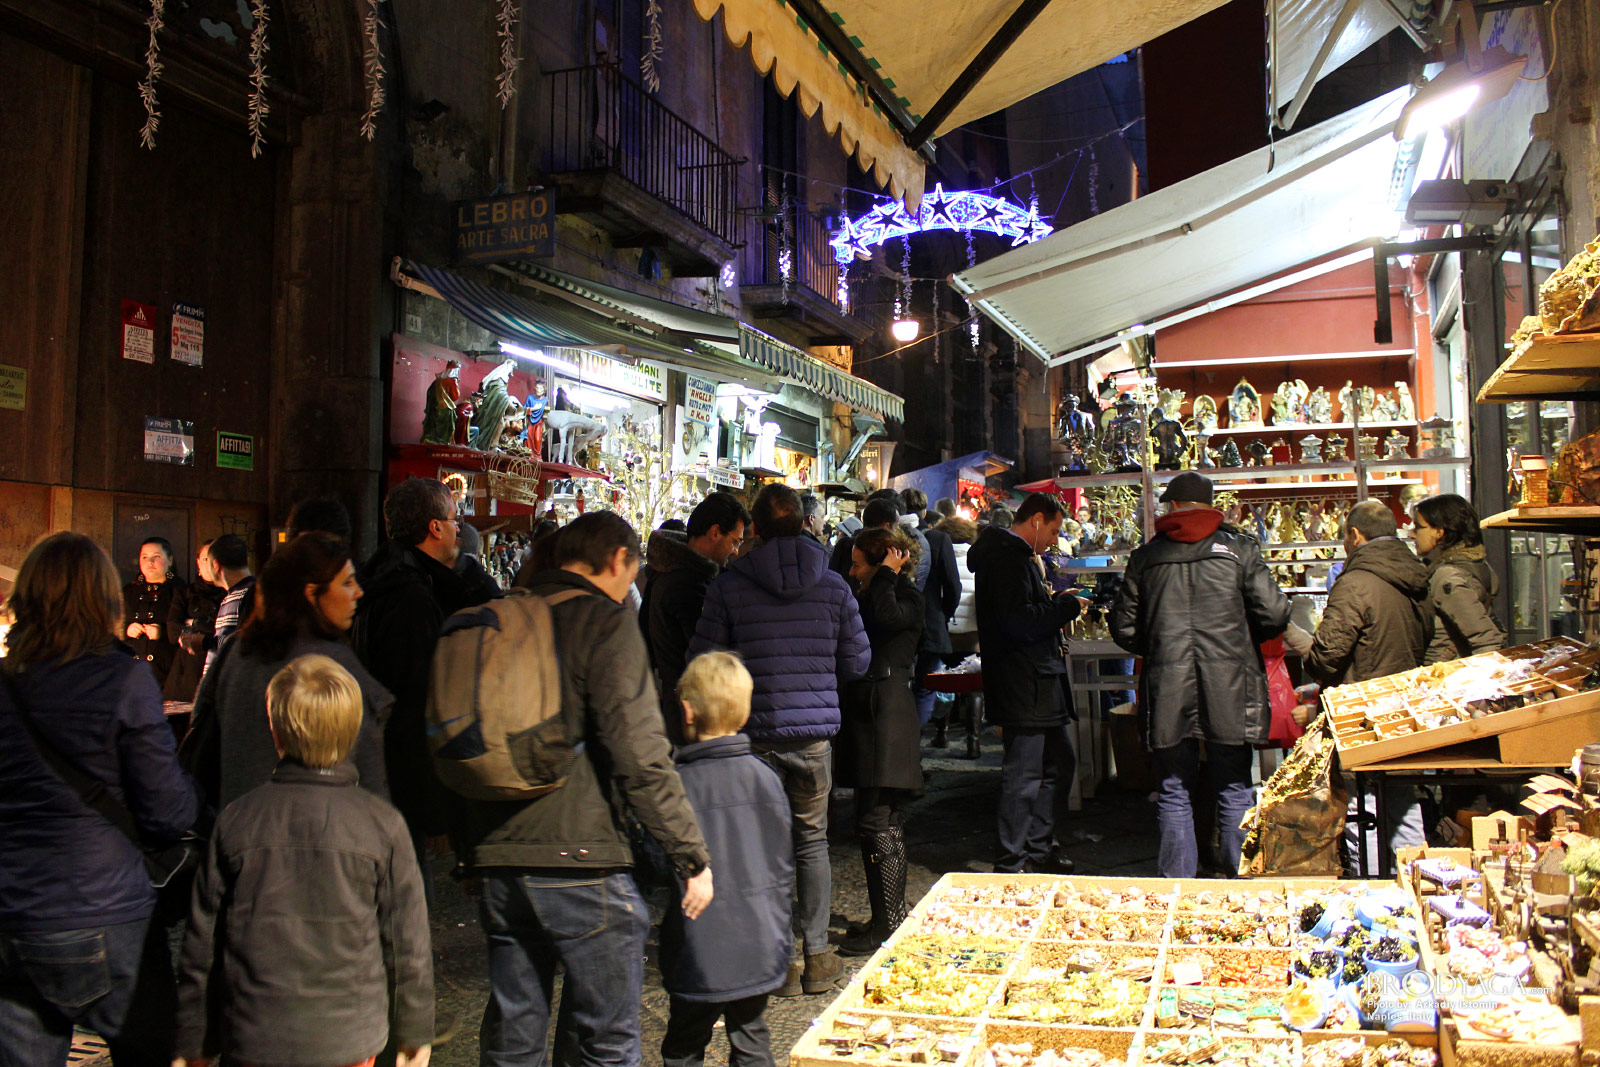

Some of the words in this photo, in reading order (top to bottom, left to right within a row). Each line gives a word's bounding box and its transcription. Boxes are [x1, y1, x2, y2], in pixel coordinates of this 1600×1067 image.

[458, 196, 548, 228] LEBRO
[457, 229, 496, 249] ARTE
[500, 222, 549, 245] SACRA
[220, 437, 251, 454] AFFITTASI
